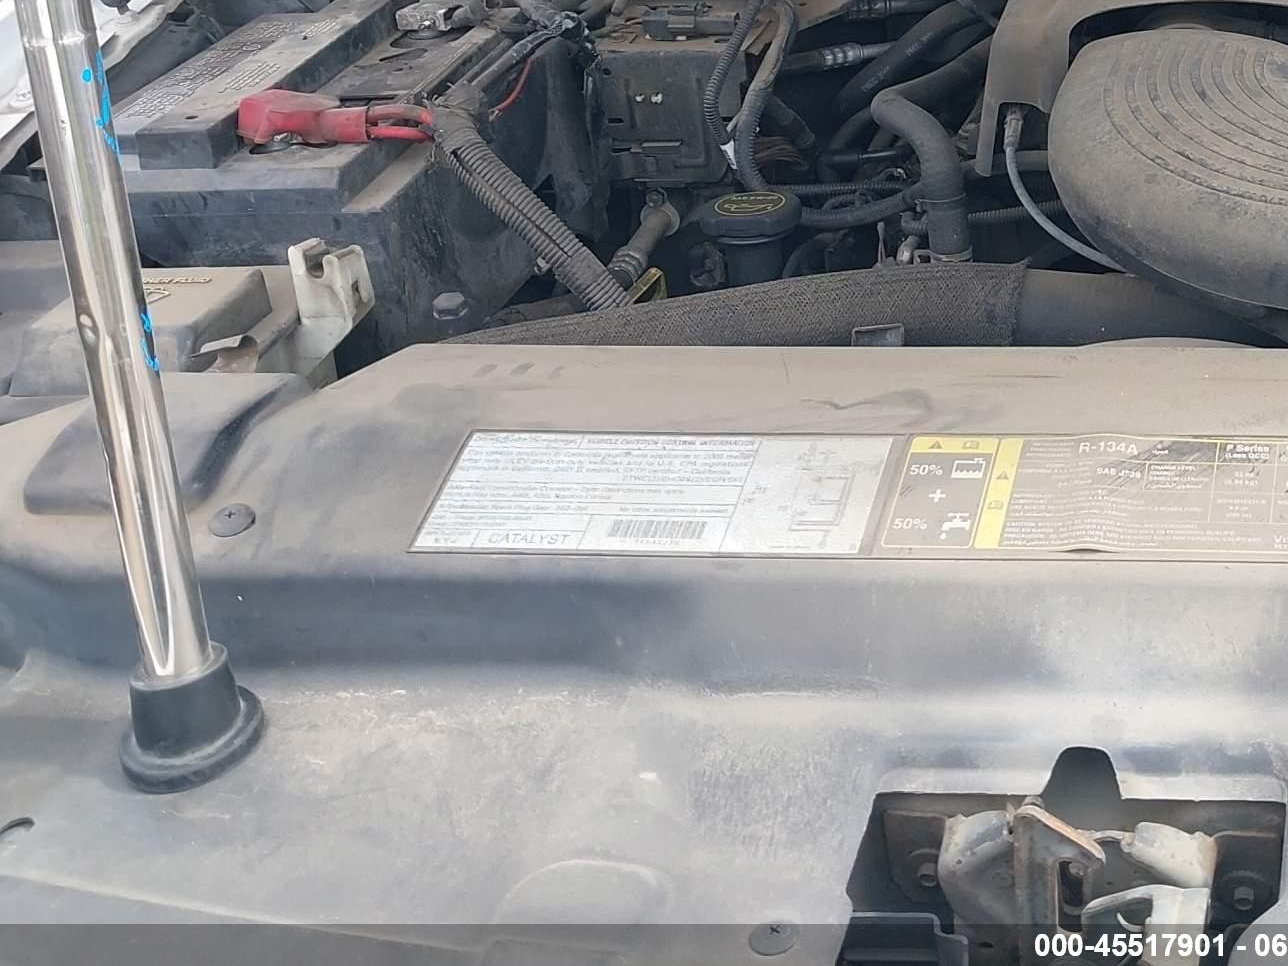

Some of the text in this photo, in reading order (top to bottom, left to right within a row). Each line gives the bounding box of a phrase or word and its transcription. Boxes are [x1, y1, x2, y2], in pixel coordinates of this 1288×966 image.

[1079, 441, 1139, 455] R-134A
[1236, 444, 1270, 453] Series
[909, 464, 944, 476] 50%
[892, 518, 928, 530] 50%
[487, 533, 571, 545] CATALYST
